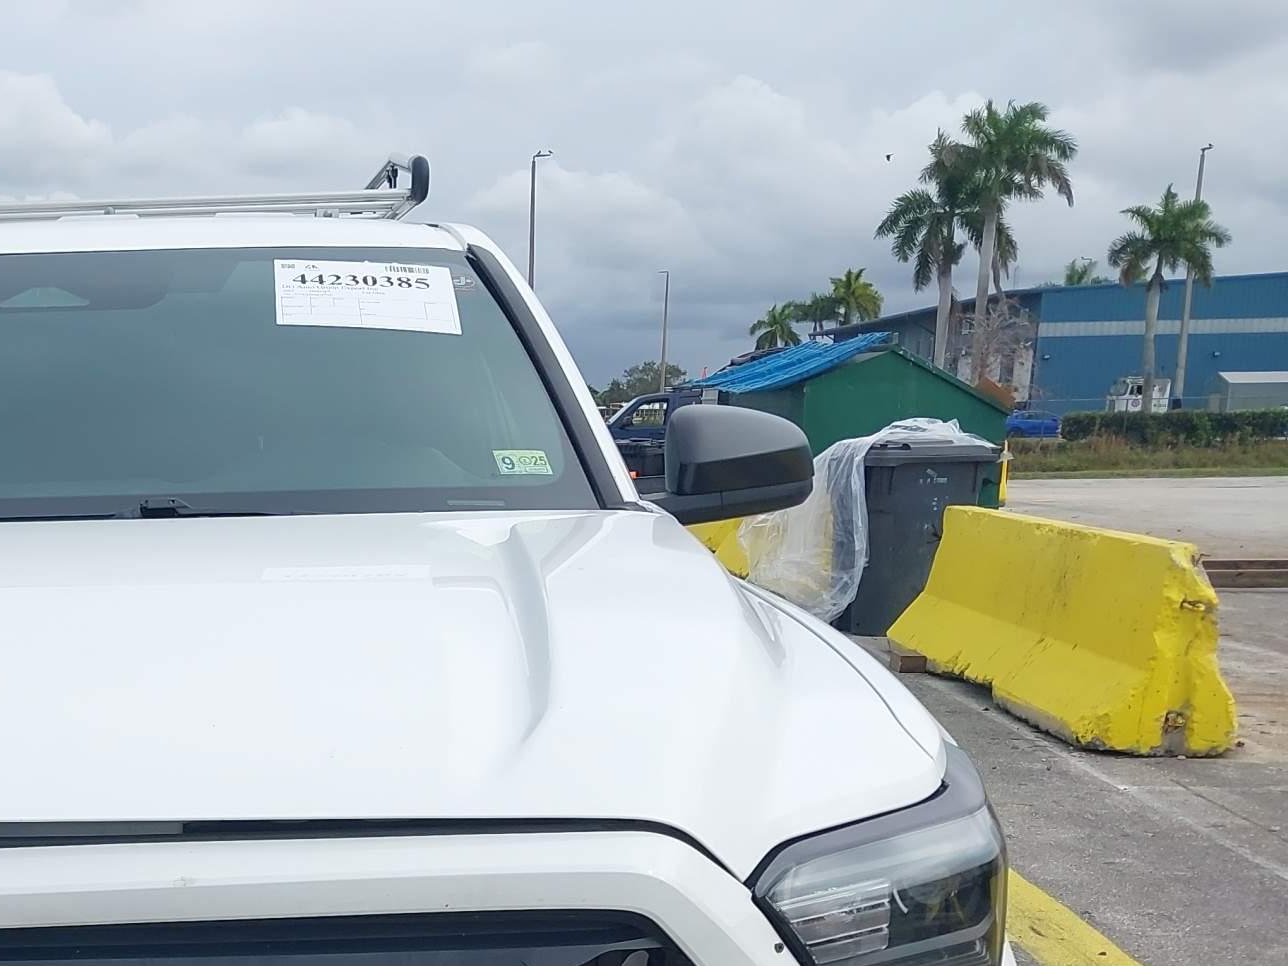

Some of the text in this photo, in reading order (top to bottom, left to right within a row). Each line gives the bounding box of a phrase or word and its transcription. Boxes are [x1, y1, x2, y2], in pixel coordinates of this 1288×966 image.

[292, 273, 430, 290] 44230385
[501, 456, 516, 471] 9
[530, 455, 548, 466] 25
